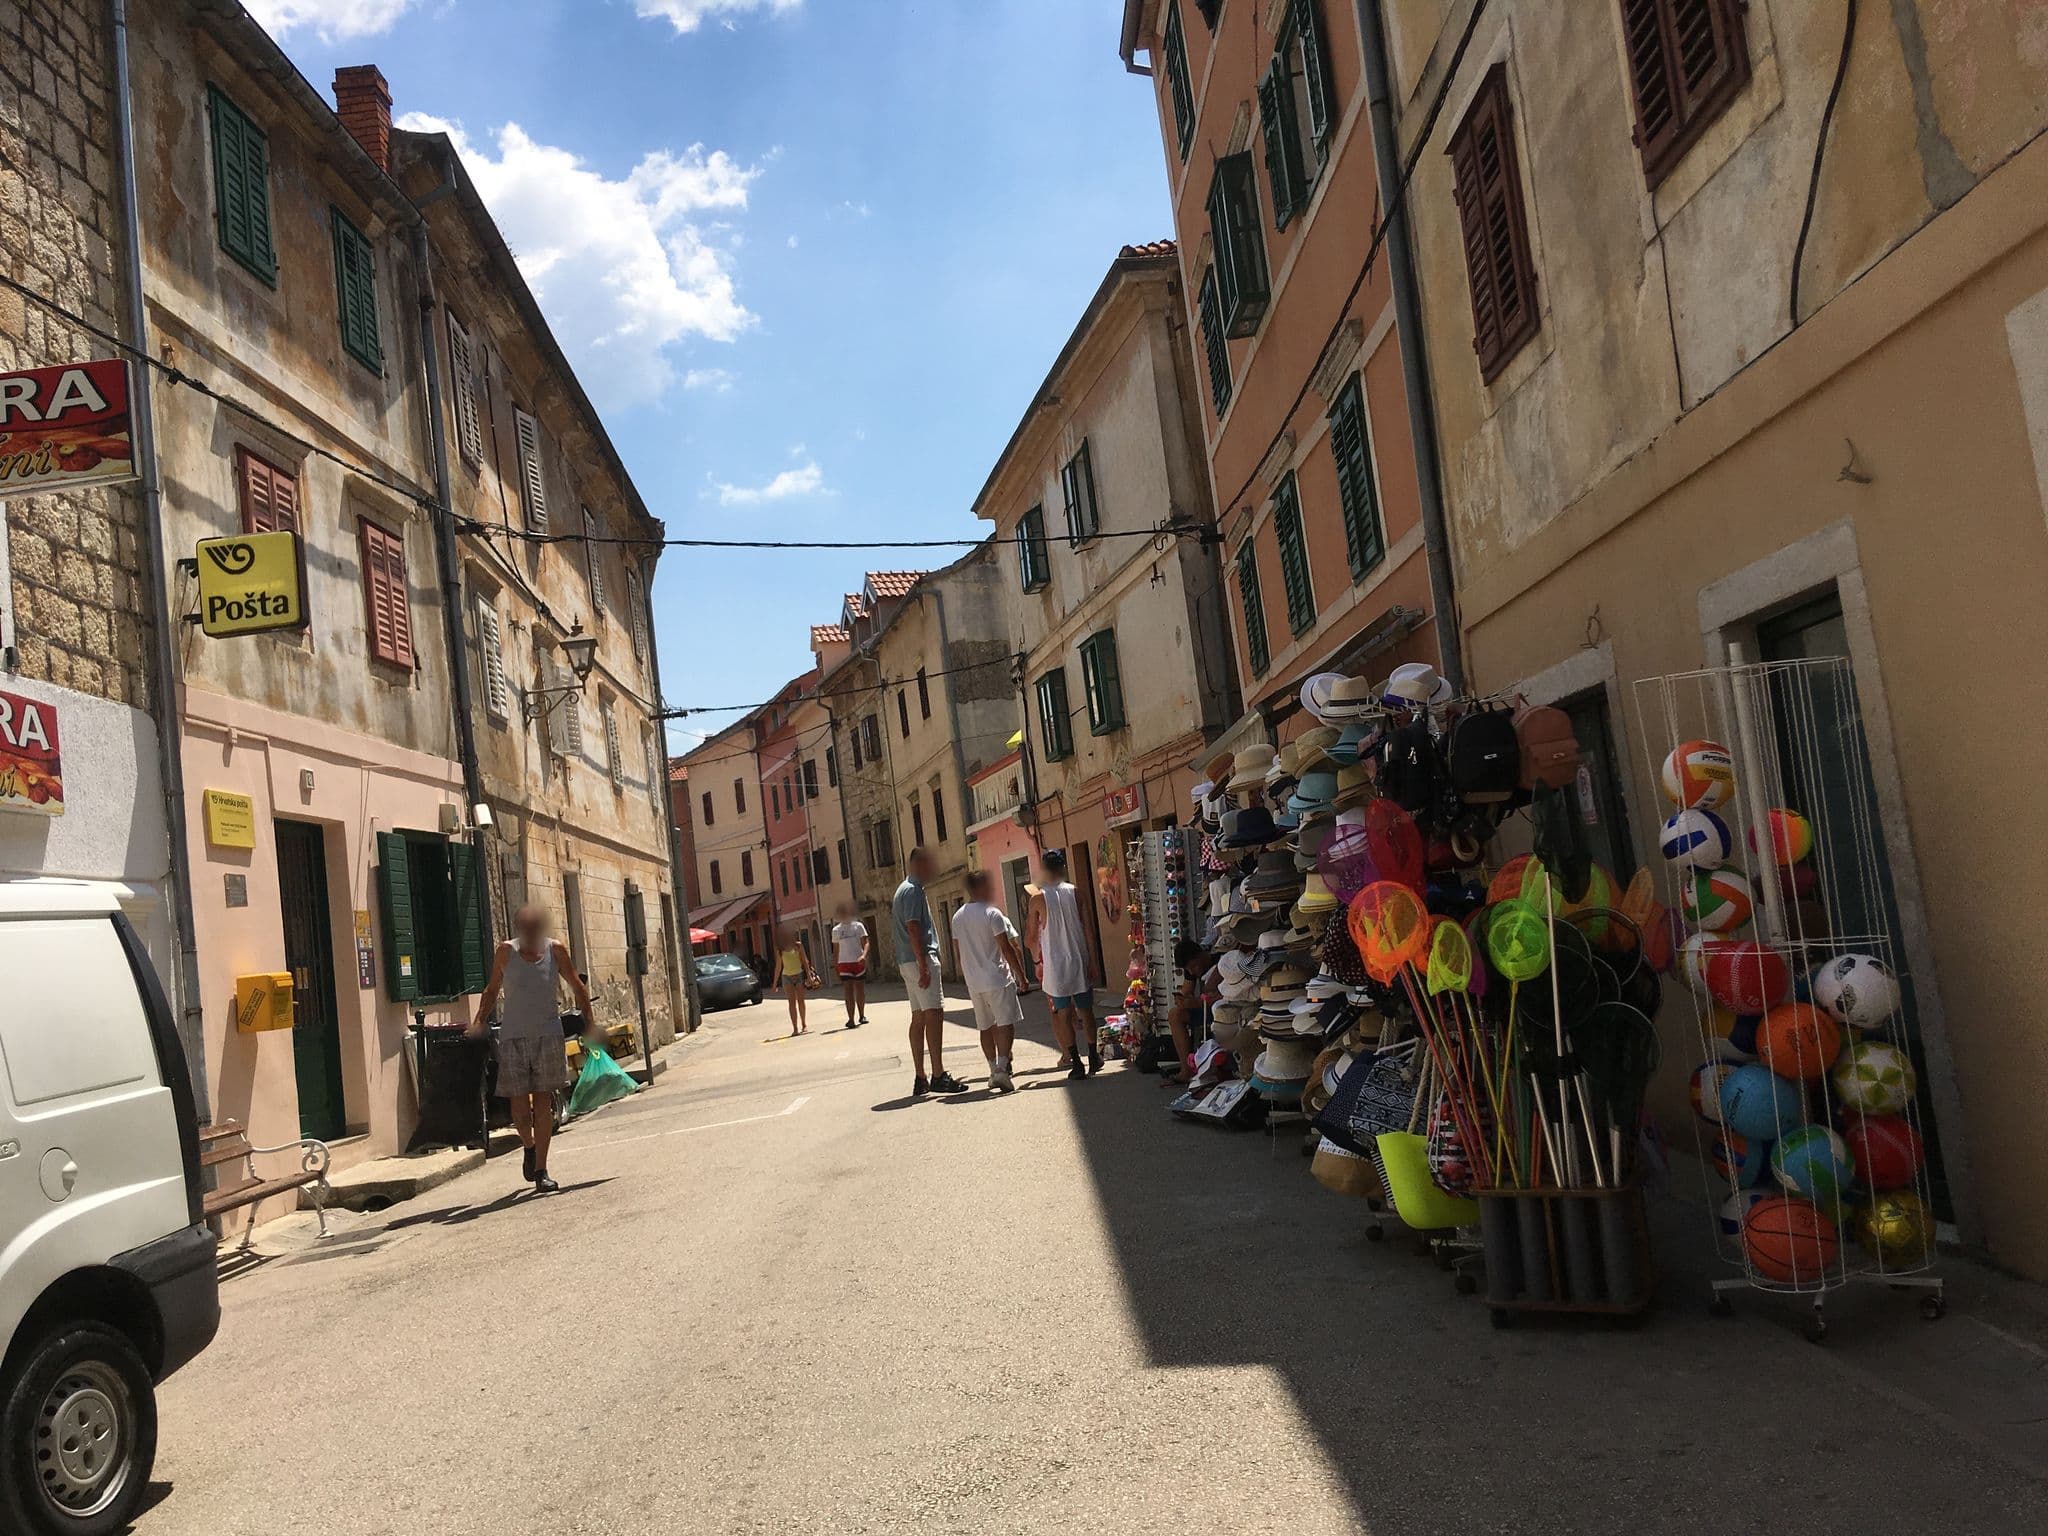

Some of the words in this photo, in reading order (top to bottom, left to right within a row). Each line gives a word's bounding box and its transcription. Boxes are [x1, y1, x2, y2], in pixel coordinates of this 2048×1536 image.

[0, 369, 107, 424] RA
[0, 433, 53, 480] ni
[208, 590, 289, 623] Pošta
